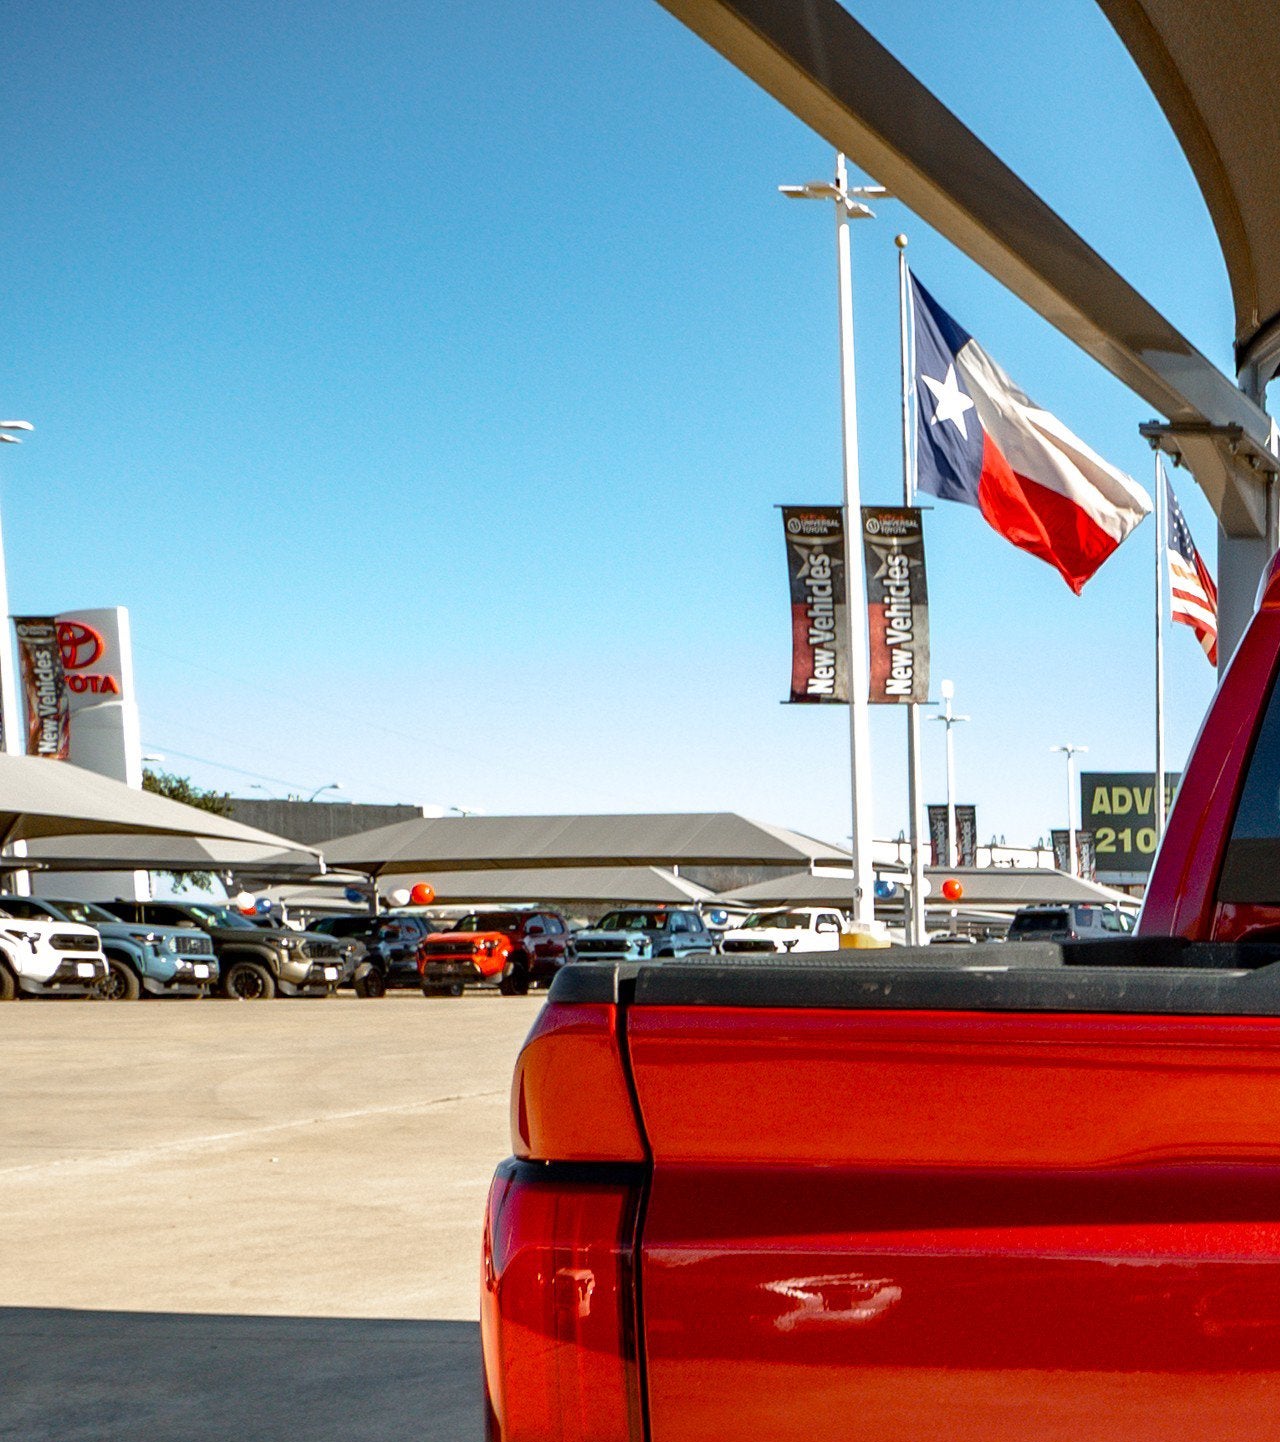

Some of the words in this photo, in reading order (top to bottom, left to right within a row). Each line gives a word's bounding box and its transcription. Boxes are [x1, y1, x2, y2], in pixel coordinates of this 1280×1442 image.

[805, 554, 835, 646] Vehicles
[883, 554, 914, 646] Vehicles
[33, 649, 57, 716] Vehicles
[64, 674, 119, 695] OTA
[807, 647, 835, 694] New
[885, 648, 914, 694] New
[38, 718, 58, 753] New
[1096, 826, 1158, 854] 210
